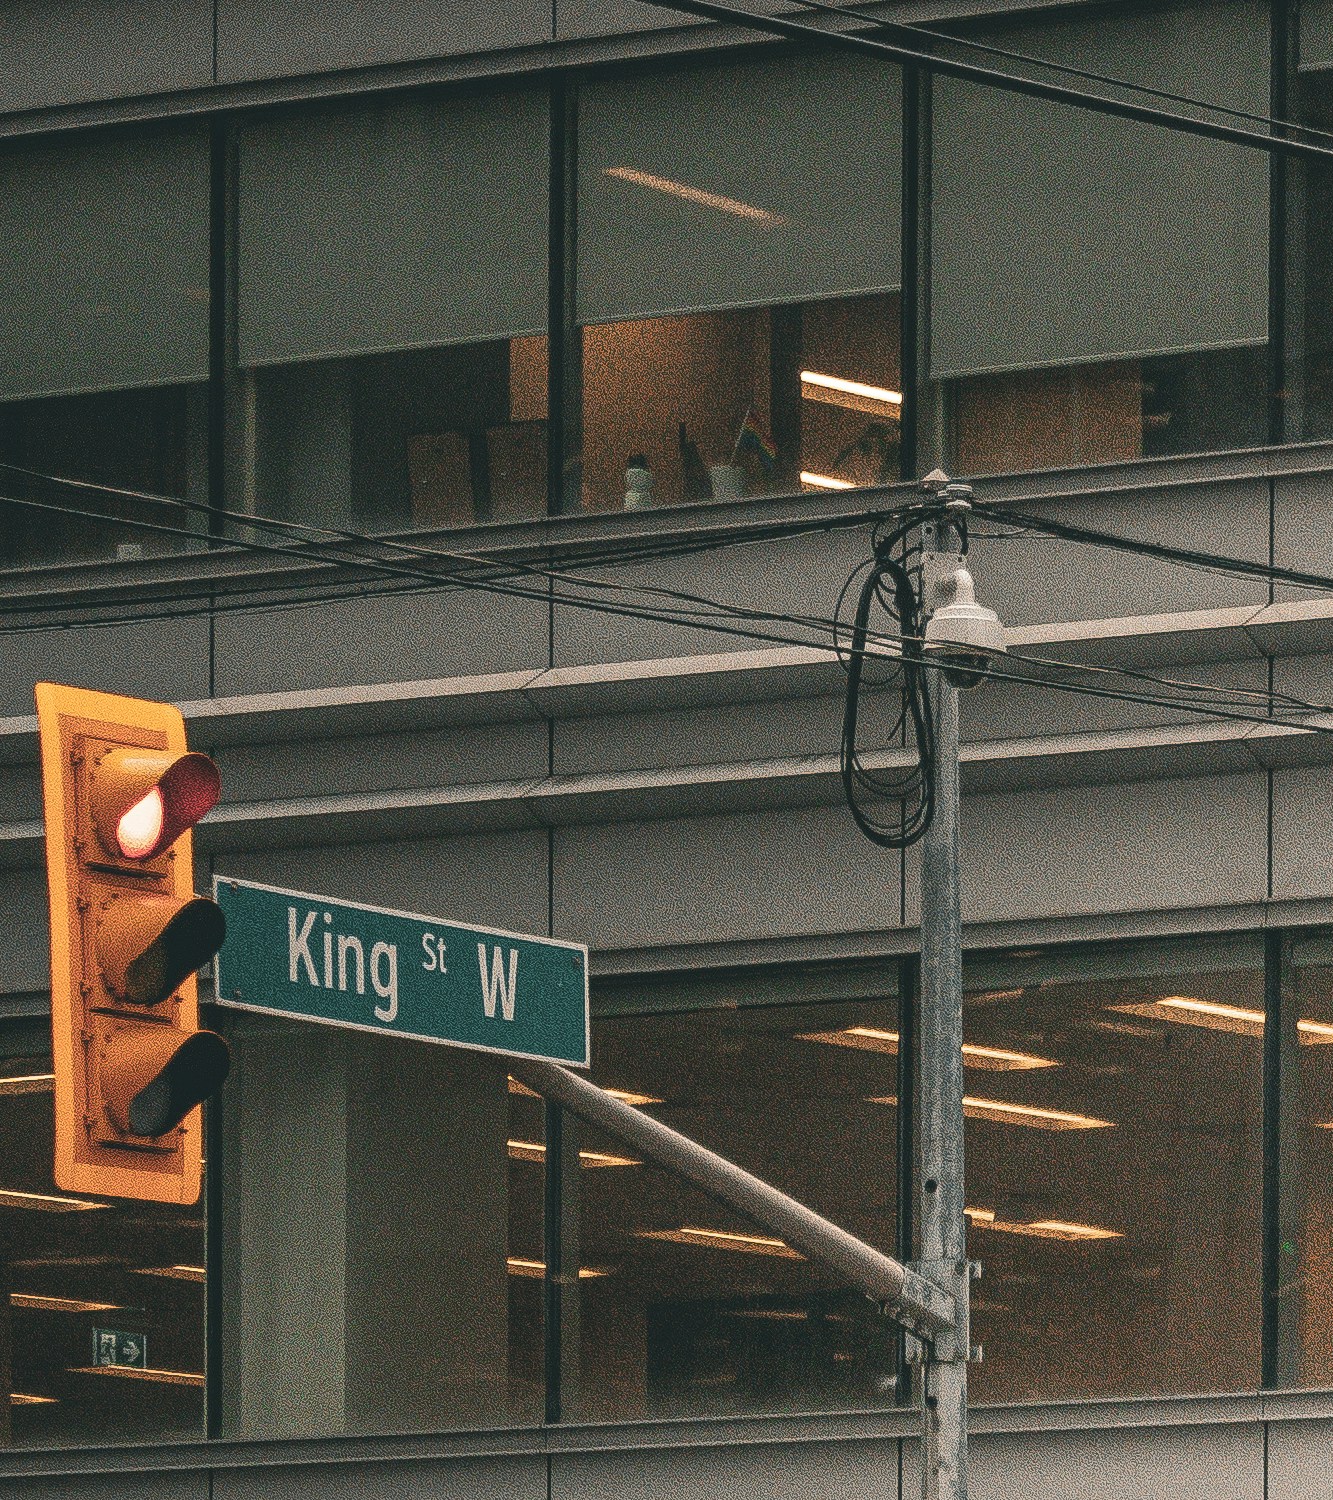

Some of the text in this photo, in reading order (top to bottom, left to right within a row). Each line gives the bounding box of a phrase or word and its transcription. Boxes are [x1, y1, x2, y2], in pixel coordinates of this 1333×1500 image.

[287, 906, 519, 1022] King St W
